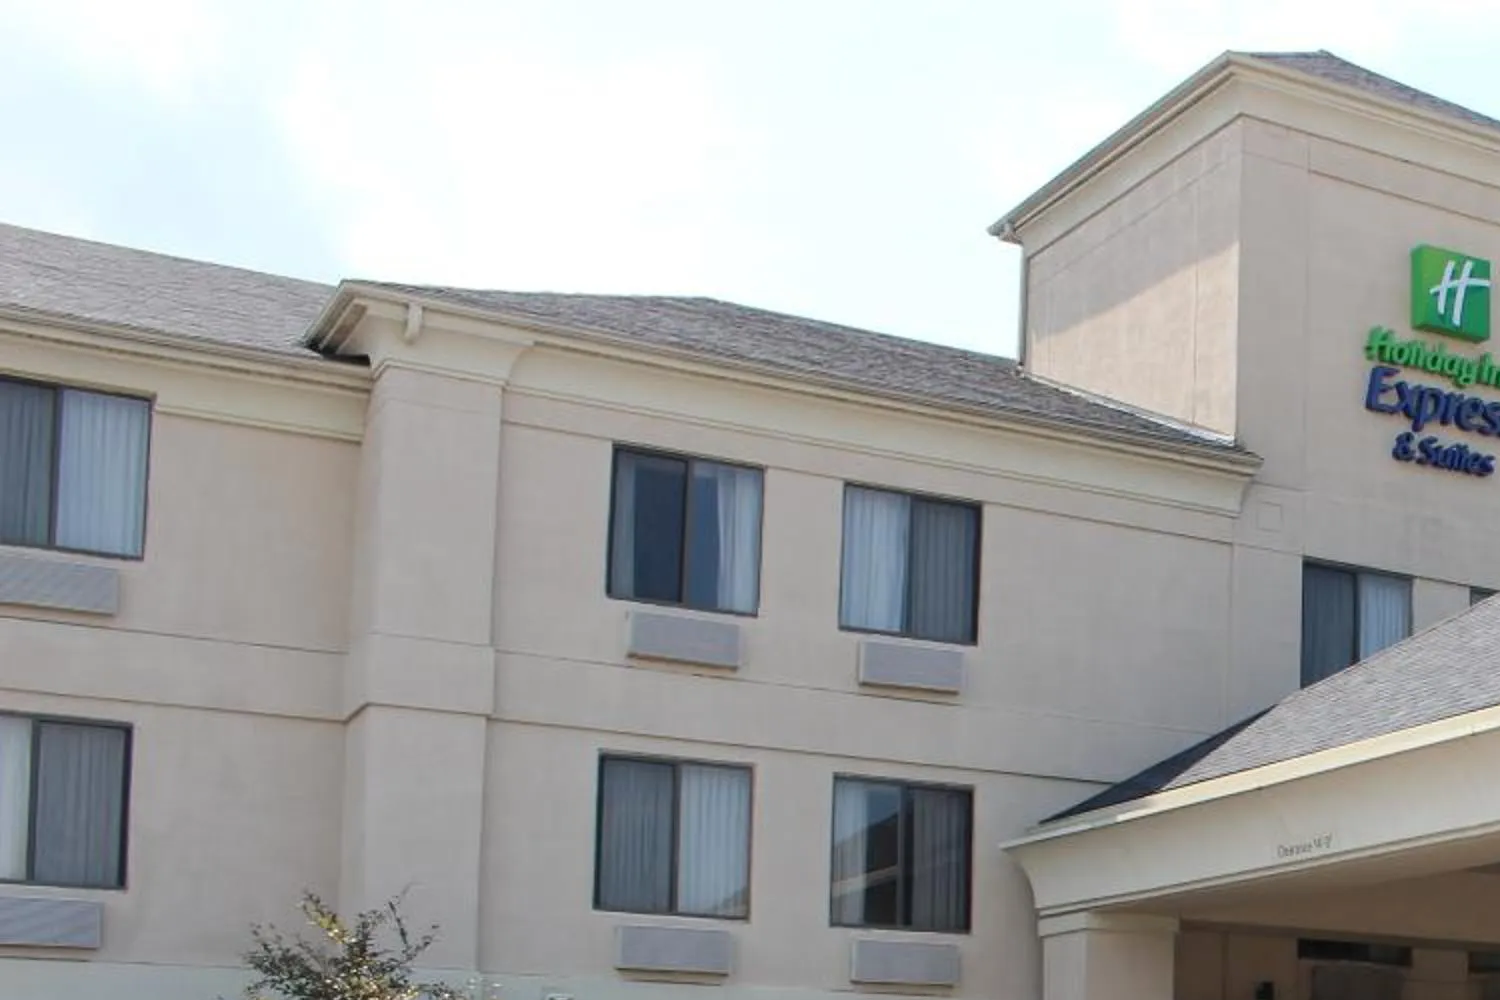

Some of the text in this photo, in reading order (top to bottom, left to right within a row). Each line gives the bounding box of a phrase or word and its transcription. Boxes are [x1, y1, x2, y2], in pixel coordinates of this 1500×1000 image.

[1364, 325, 1479, 389] Holiday
[1391, 431, 1496, 477] & Suites
